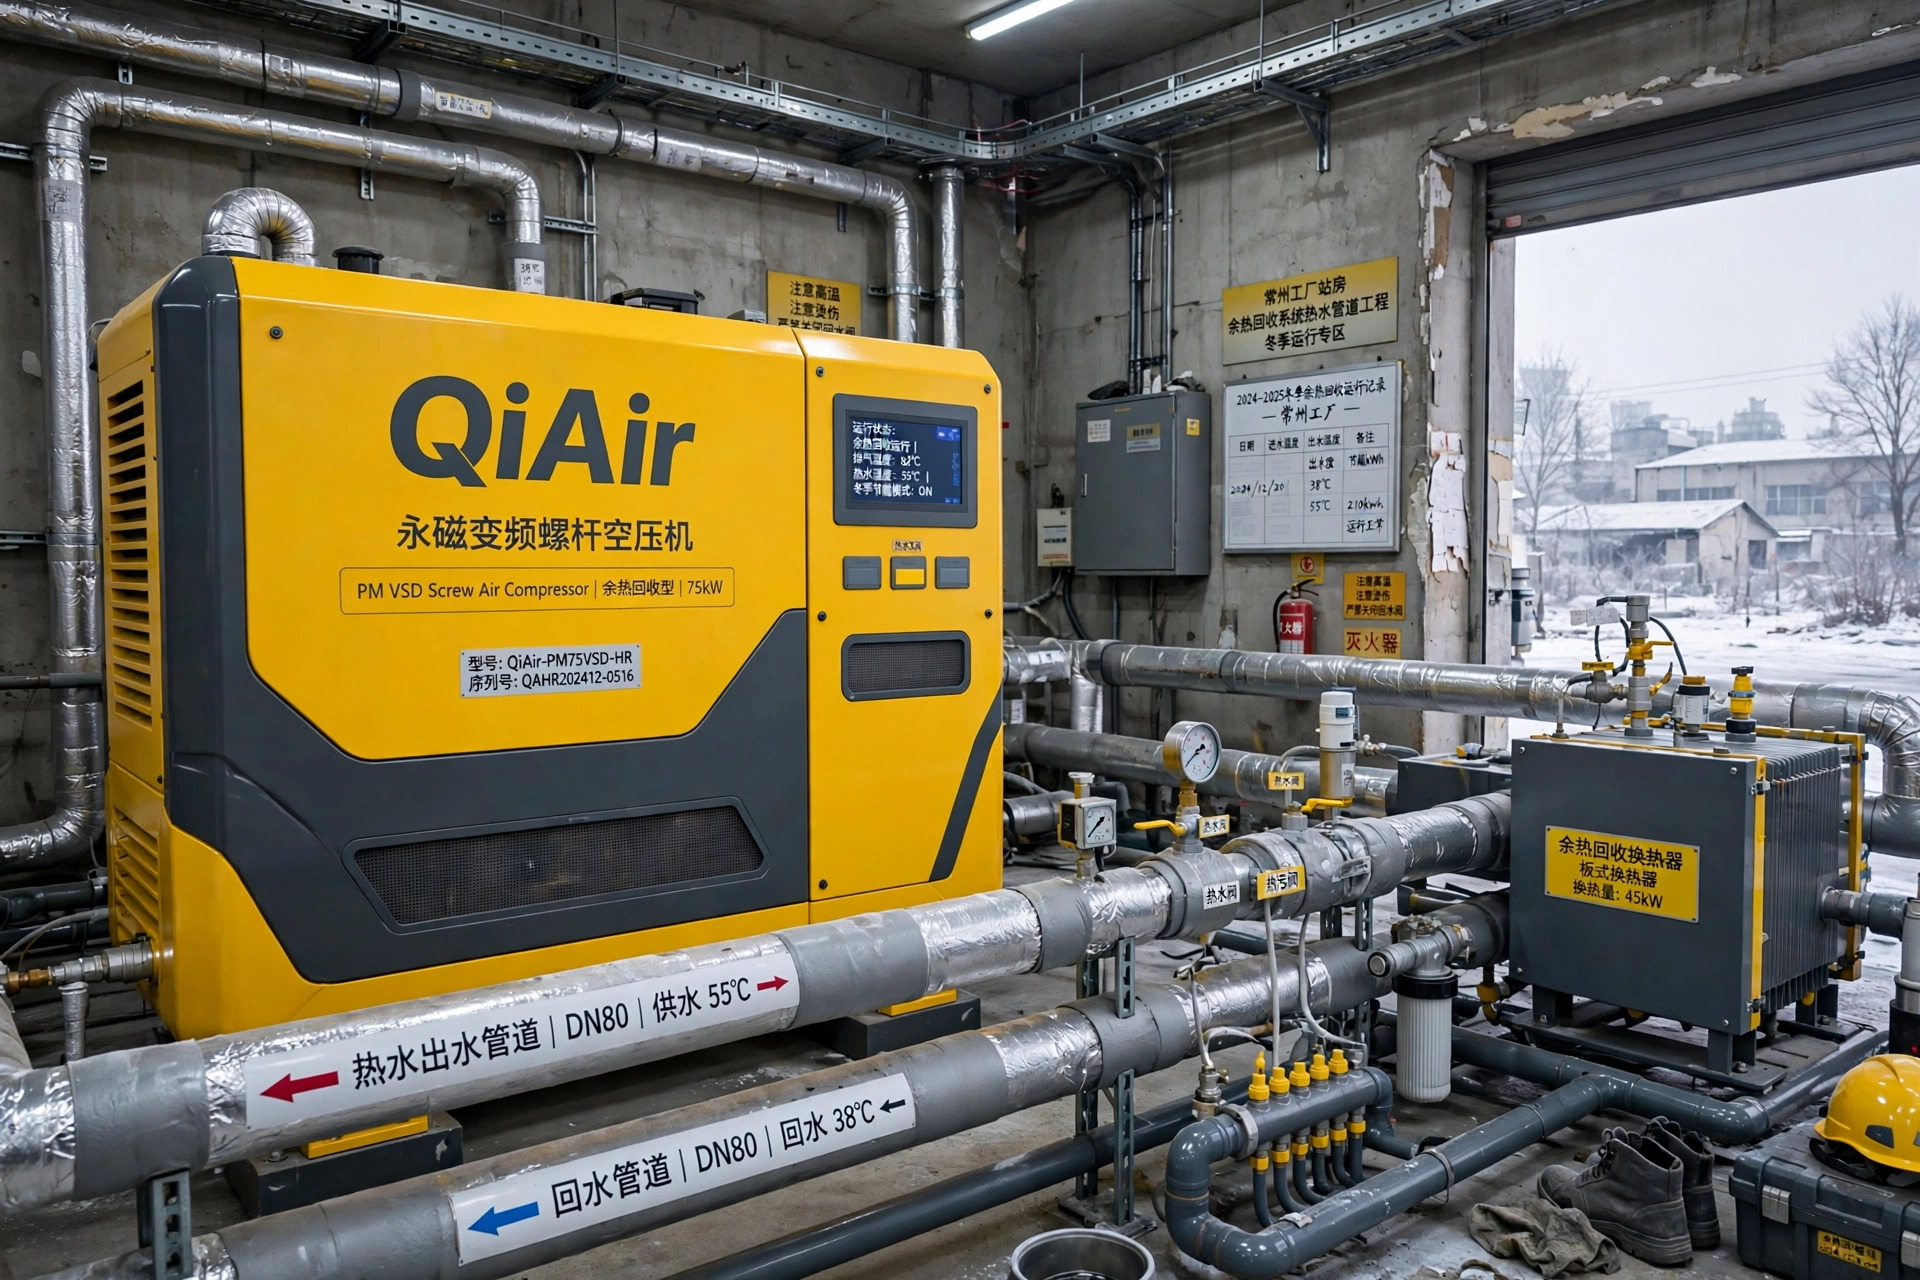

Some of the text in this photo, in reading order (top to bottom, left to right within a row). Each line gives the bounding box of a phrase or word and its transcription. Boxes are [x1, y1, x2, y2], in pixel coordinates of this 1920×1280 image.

[790, 281, 840, 302] 注意高温
[1264, 275, 1347, 306] 常州工厂站房
[1228, 292, 1389, 335] 余热回收系统热水管道工程
[1265, 323, 1346, 351] 冬季运行专区
[390, 376, 696, 488] QiAir
[1239, 440, 1255, 452] 日期
[1356, 431, 1375, 444] 备注
[918, 485, 933, 497] ON
[397, 514, 694, 552] 永磁变频螺杆空压机
[357, 578, 724, 600] PM VSD Screw Air Compressor 余热回收型 75kW
[1346, 631, 1400, 654] 灭火器
[468, 650, 633, 672] 型号: QiAir-PM75VSD-HR
[469, 669, 634, 692] 序列号: QAHR202412-0516
[1559, 835, 1684, 871] 余热回收换热器
[1579, 859, 1658, 888] 板式换热器
[1573, 879, 1664, 909] 换热量: 45kW
[352, 1018, 542, 1090] 热水出水管道
[565, 1001, 629, 1041] DN80
[653, 985, 702, 1023] 供水
[551, 1152, 673, 1218] 回水管道
[695, 1131, 759, 1173] DN80
[780, 1112, 828, 1150] 回水
